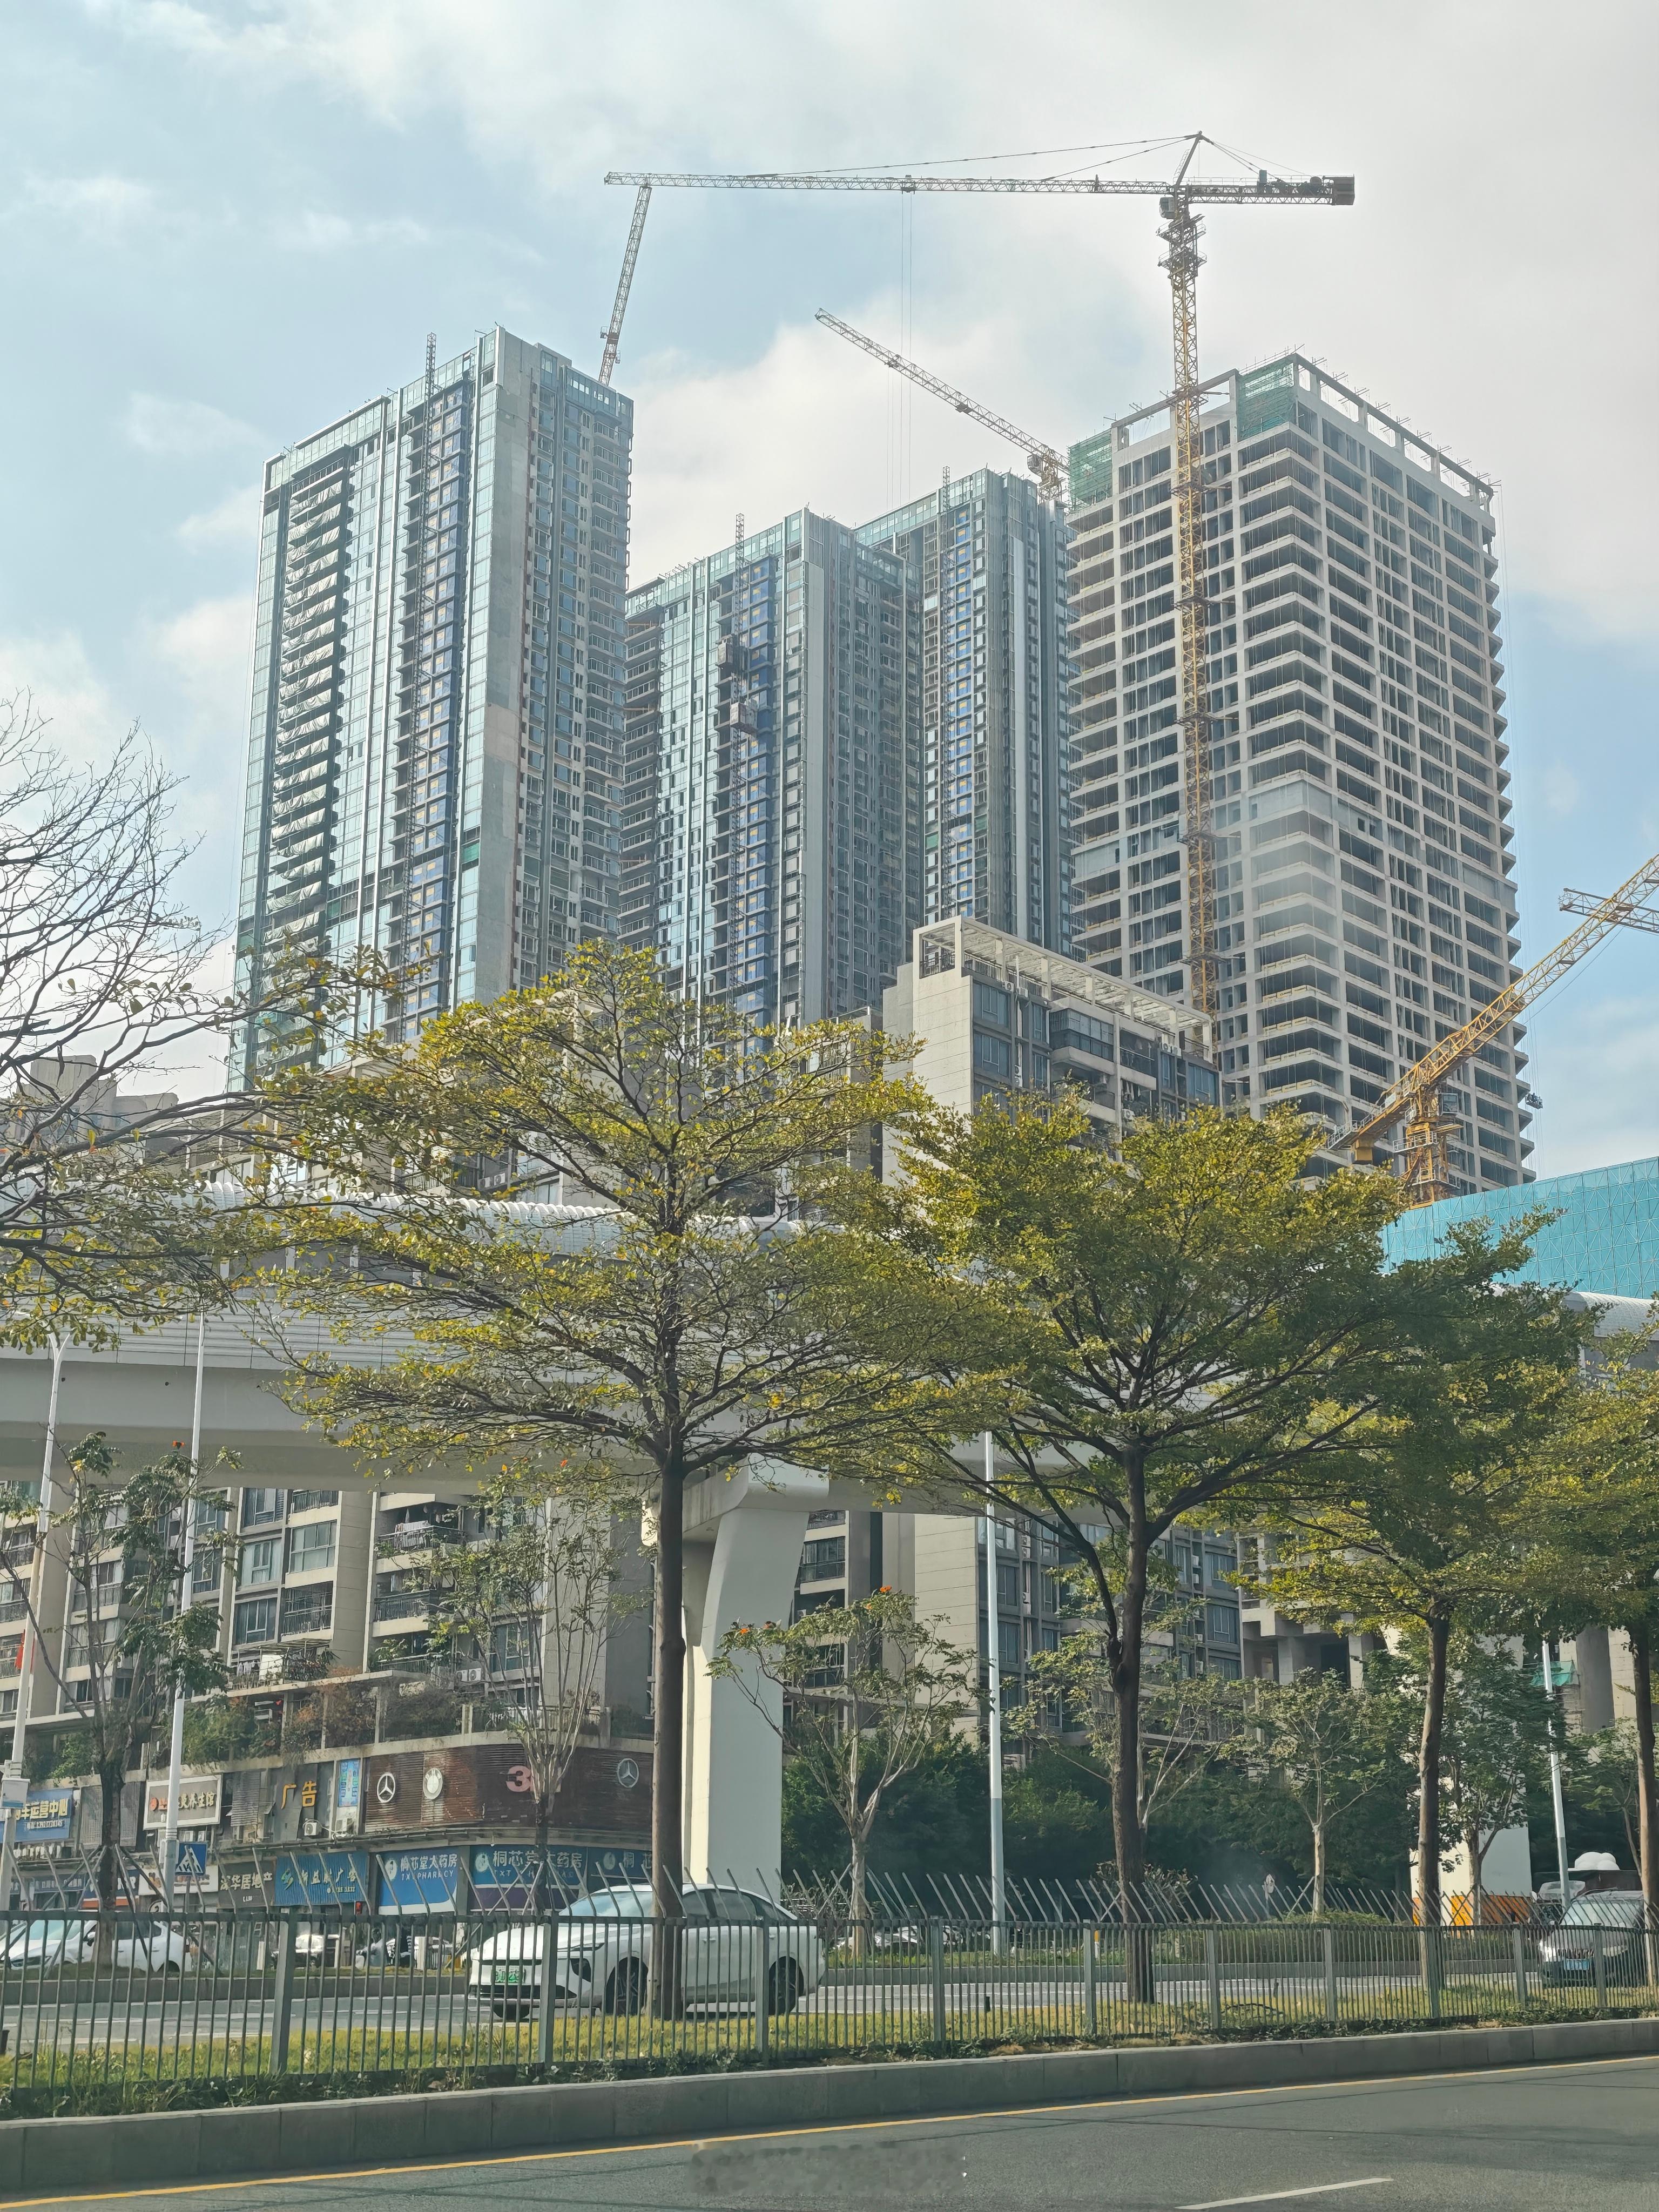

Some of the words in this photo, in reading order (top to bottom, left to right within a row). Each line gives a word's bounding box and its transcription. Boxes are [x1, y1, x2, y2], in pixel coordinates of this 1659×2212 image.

[281, 1781, 318, 1809] 广告
[400, 1853, 457, 1872] 桐芯堂大药房
